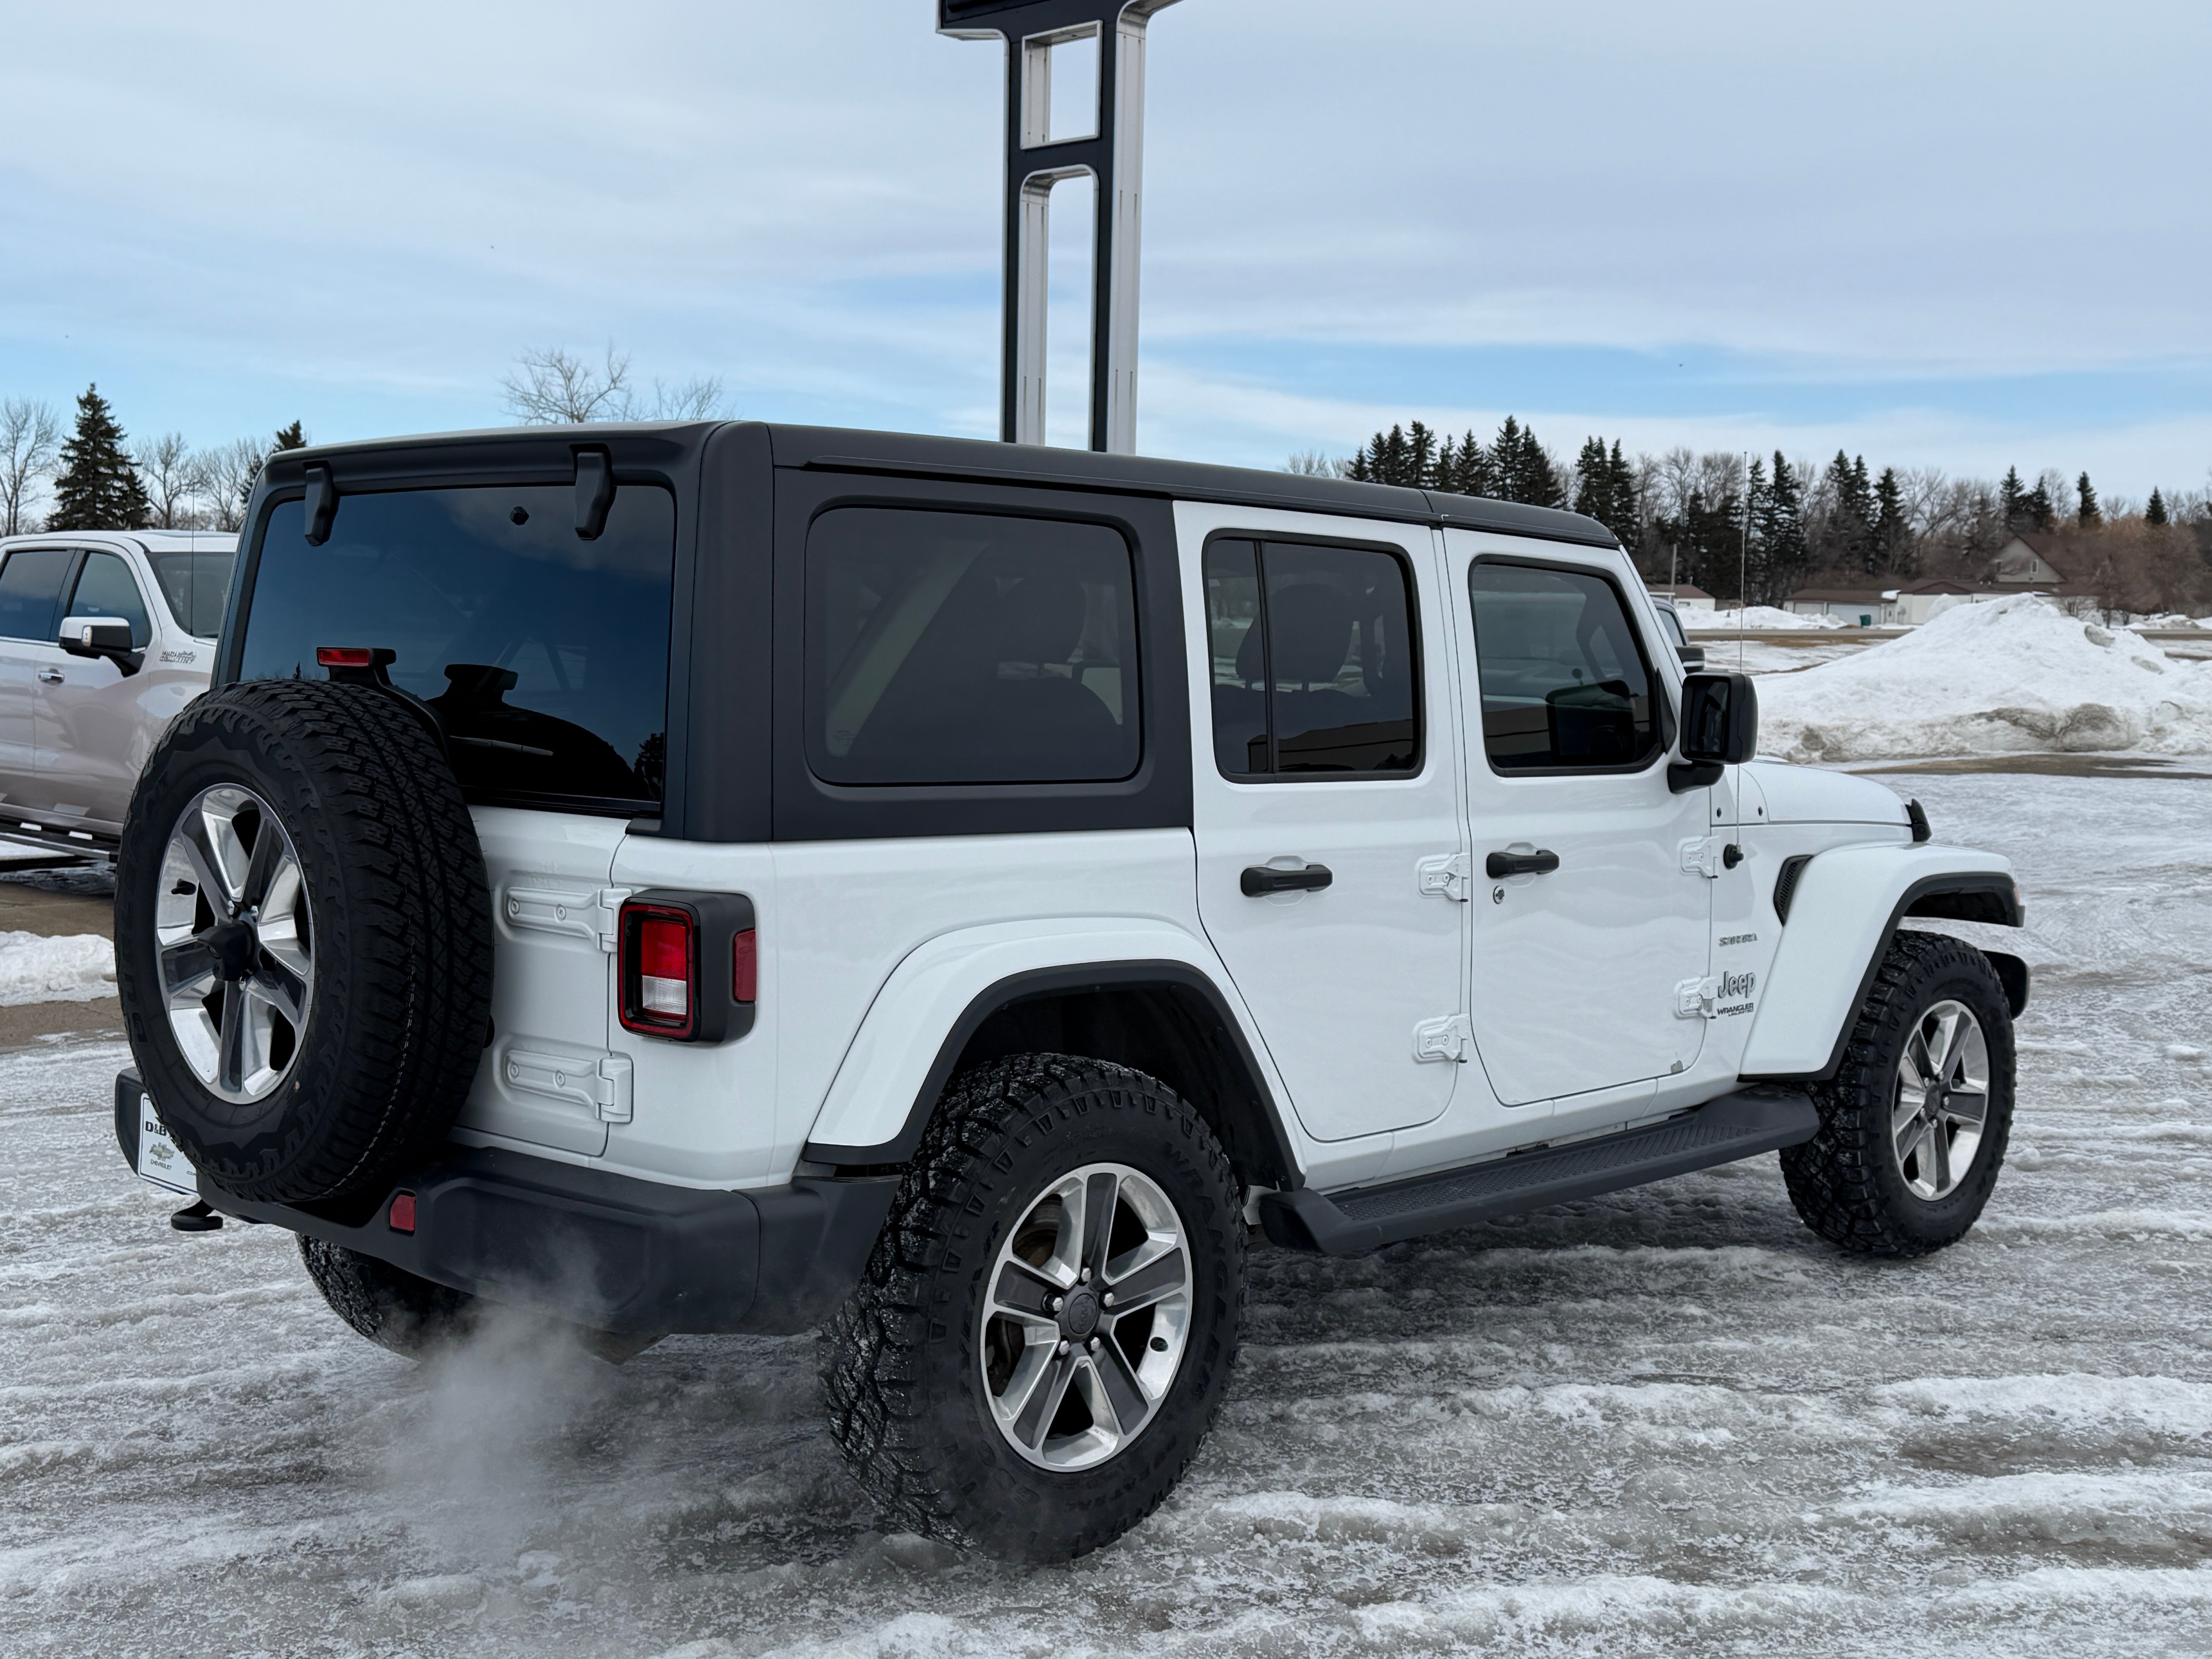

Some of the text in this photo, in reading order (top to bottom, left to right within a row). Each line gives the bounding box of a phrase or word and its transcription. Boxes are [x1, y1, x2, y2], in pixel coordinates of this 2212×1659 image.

[1717, 971, 1757, 998] Jeep
[1717, 1003, 1754, 1015] WRANGLER
[146, 1121, 167, 1136] D&B
[1162, 1140, 1228, 1400] WRANGLER
